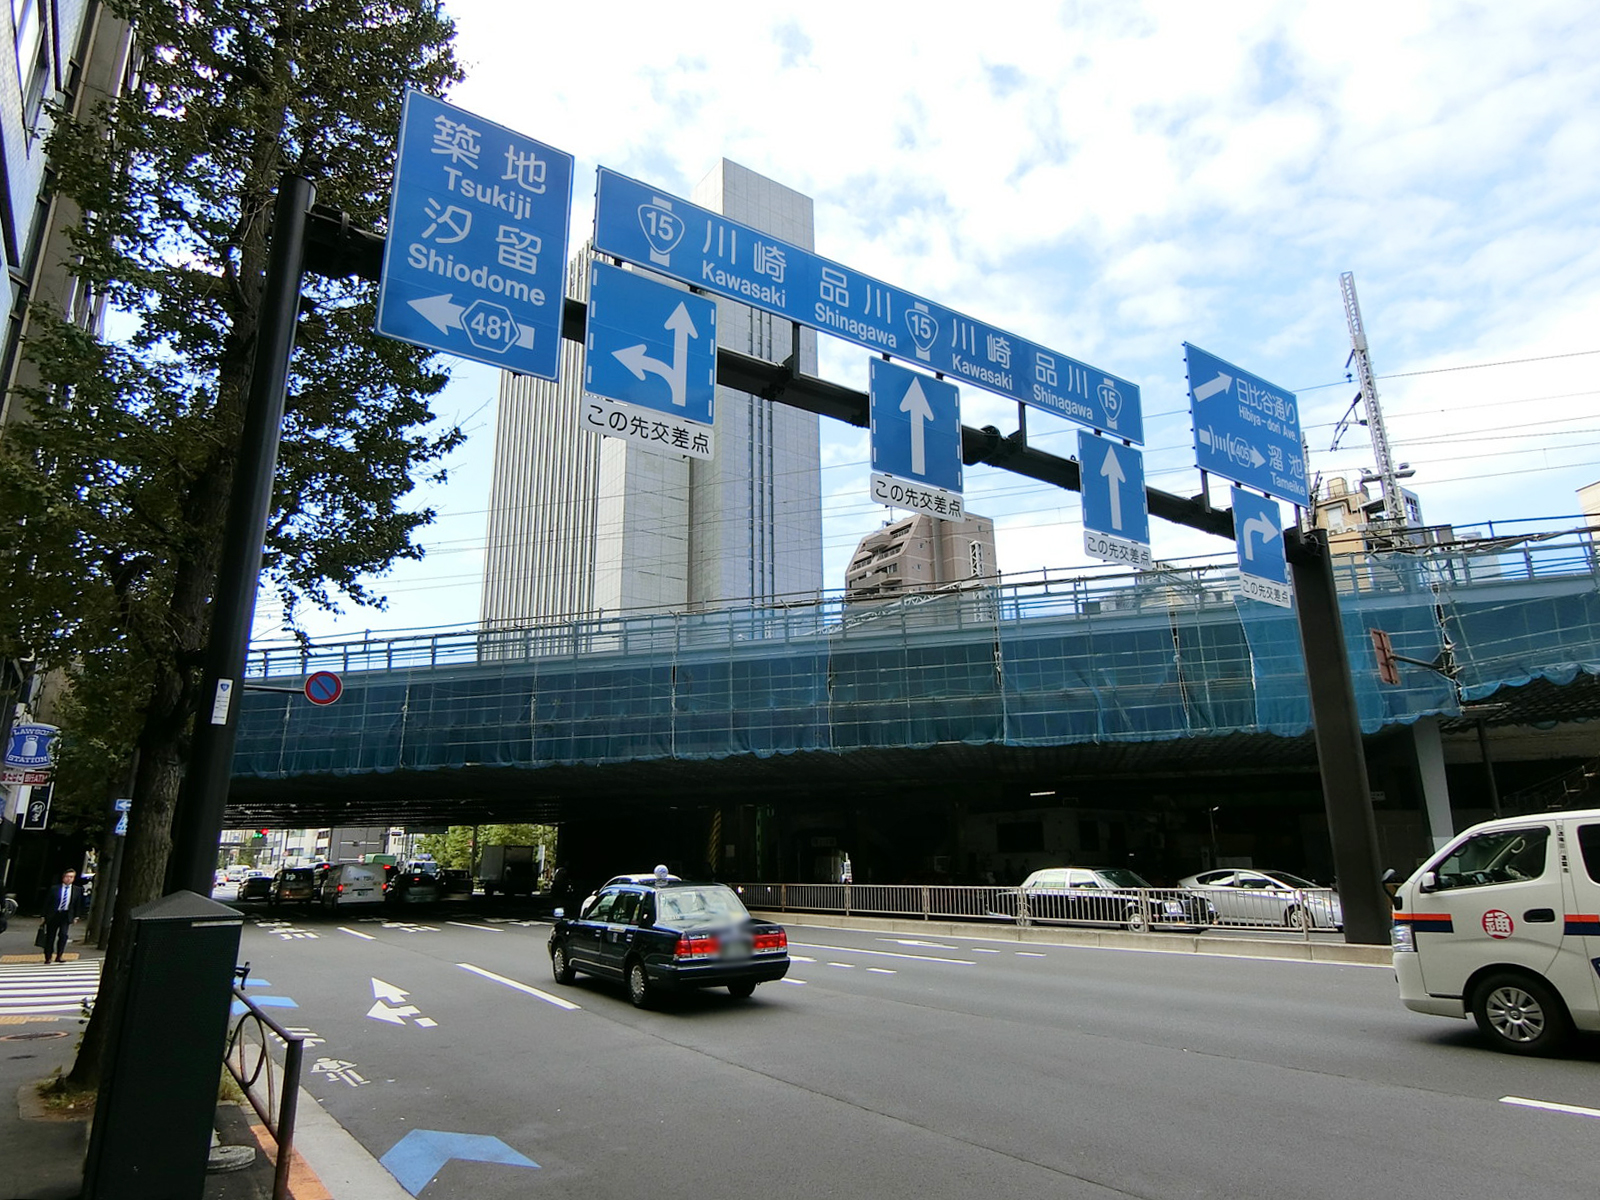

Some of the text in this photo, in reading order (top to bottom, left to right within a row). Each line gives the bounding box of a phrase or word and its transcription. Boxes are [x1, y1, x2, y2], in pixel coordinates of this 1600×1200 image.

[431, 115, 546, 195] 築地
[443, 167, 532, 220] Tsukiji
[422, 197, 542, 276] 汐留
[647, 210, 675, 240] 15
[407, 243, 546, 307] Shiodome
[702, 220, 891, 324] 川崎 品川
[702, 260, 897, 348] Kawasaki Shinagawa
[471, 311, 512, 343] 481
[911, 315, 931, 336] 15
[951, 318, 1088, 399] 川崎 品川
[952, 353, 1093, 420] Kawasaki Shinagawa
[1102, 388, 1118, 409] 15
[1236, 378, 1296, 424] 日比谷通り
[586, 403, 710, 454] この先交差点
[1283, 424, 1298, 442] Ave.
[1236, 444, 1250, 461] 405
[1267, 443, 1304, 480] 溜池
[874, 480, 961, 518] この先交差点
[1270, 472, 1306, 496] Tameike
[1087, 536, 1151, 566] この先交差点
[1242, 579, 1289, 602] この先交差点
[8, 755, 47, 763] STATION
[1484, 911, 1512, 937] 通
